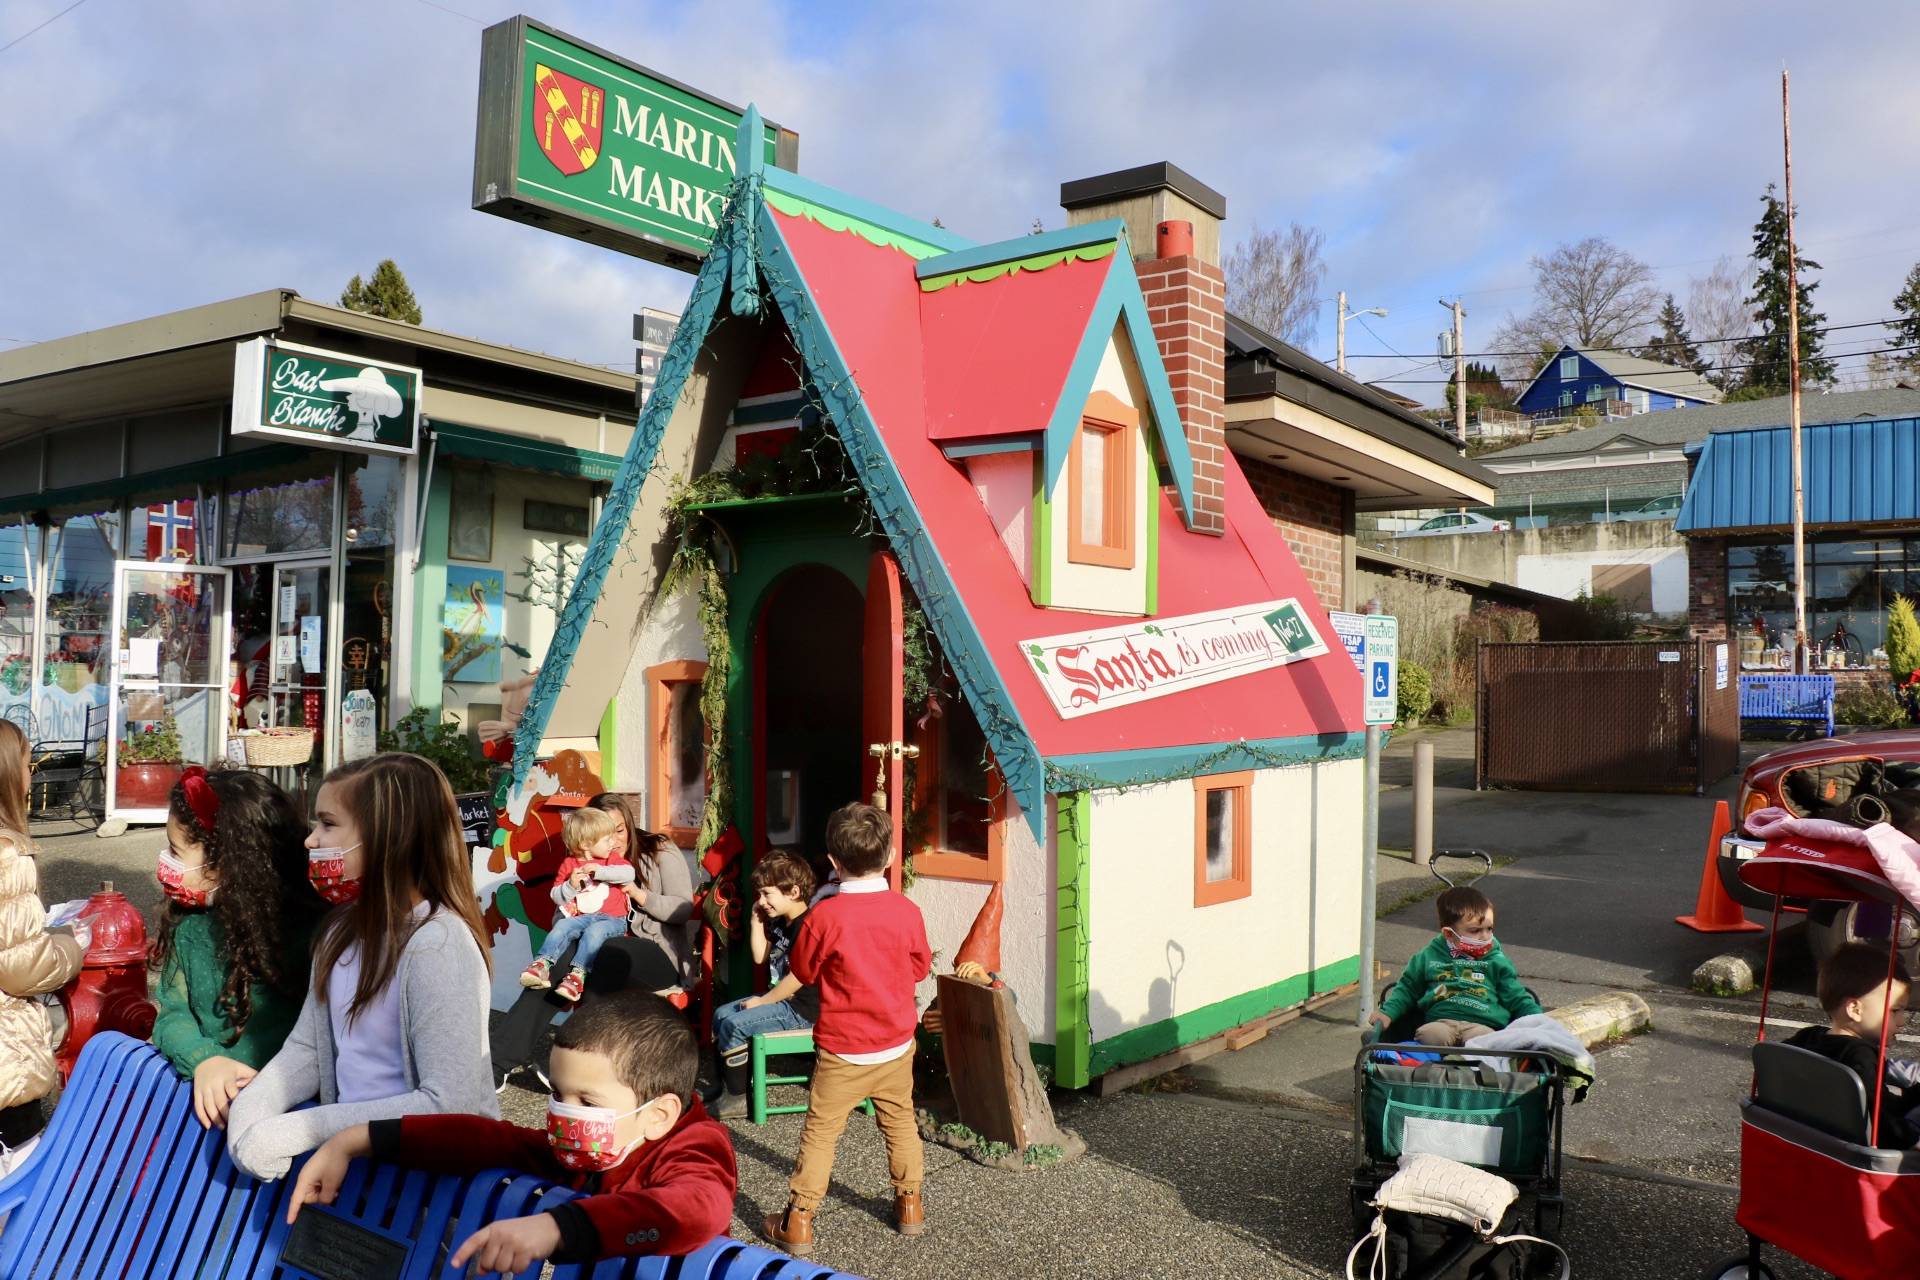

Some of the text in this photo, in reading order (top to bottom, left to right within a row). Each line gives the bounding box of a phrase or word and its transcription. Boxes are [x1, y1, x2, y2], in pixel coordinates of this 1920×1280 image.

[612, 94, 737, 177] MARIN
[607, 155, 731, 229] MARK
[271, 357, 327, 394] Bad
[270, 396, 347, 432] Blanche
[1337, 634, 1362, 646] ITSAP
[1368, 624, 1395, 639] RESERVED
[1055, 634, 1175, 708] Santa
[1173, 630, 1200, 675] is
[1201, 618, 1281, 661] coming
[1369, 643, 1394, 657] PARKING
[40, 693, 84, 739] GNOM
[351, 709, 371, 728] Team
